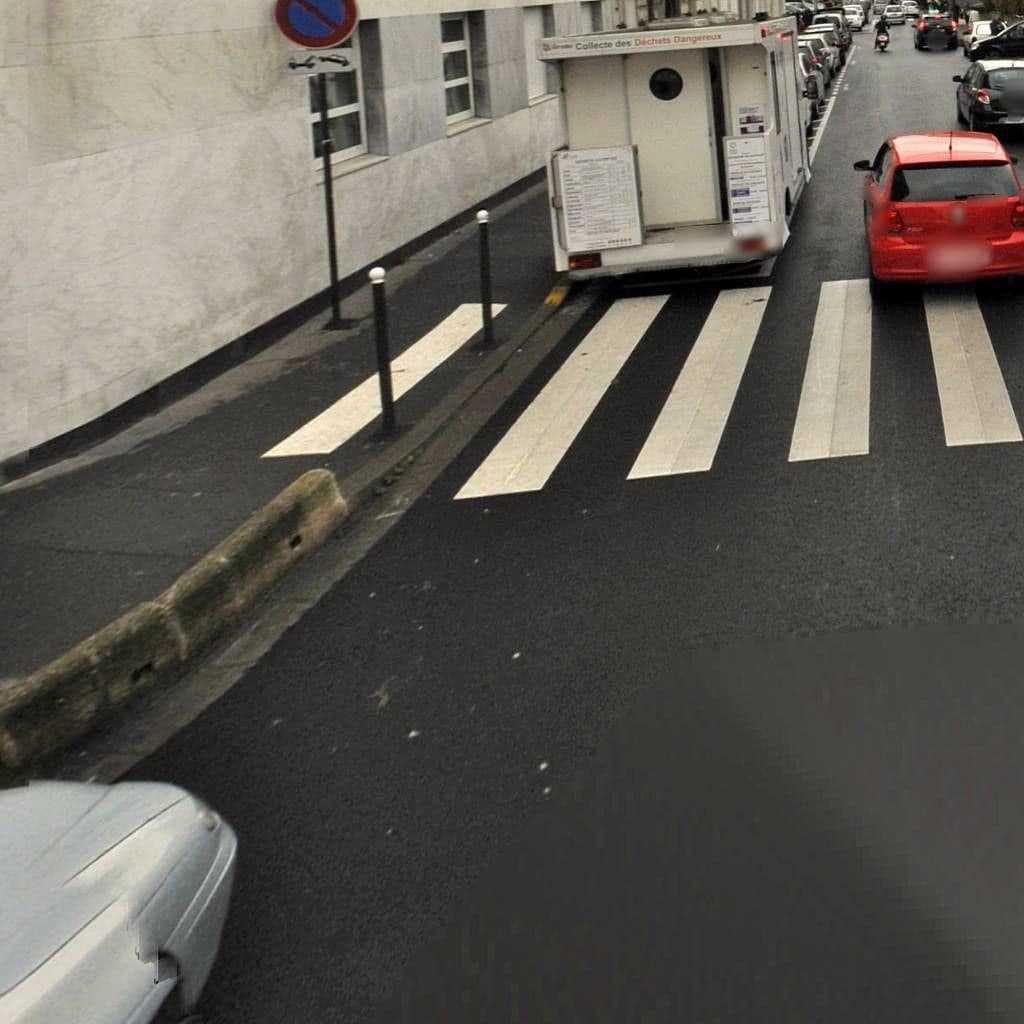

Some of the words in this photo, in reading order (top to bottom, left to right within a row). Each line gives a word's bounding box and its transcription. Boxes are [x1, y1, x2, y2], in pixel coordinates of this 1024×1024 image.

[575, 41, 613, 50] Collecte
[615, 39, 632, 48] des
[673, 33, 722, 45] Dangereux
